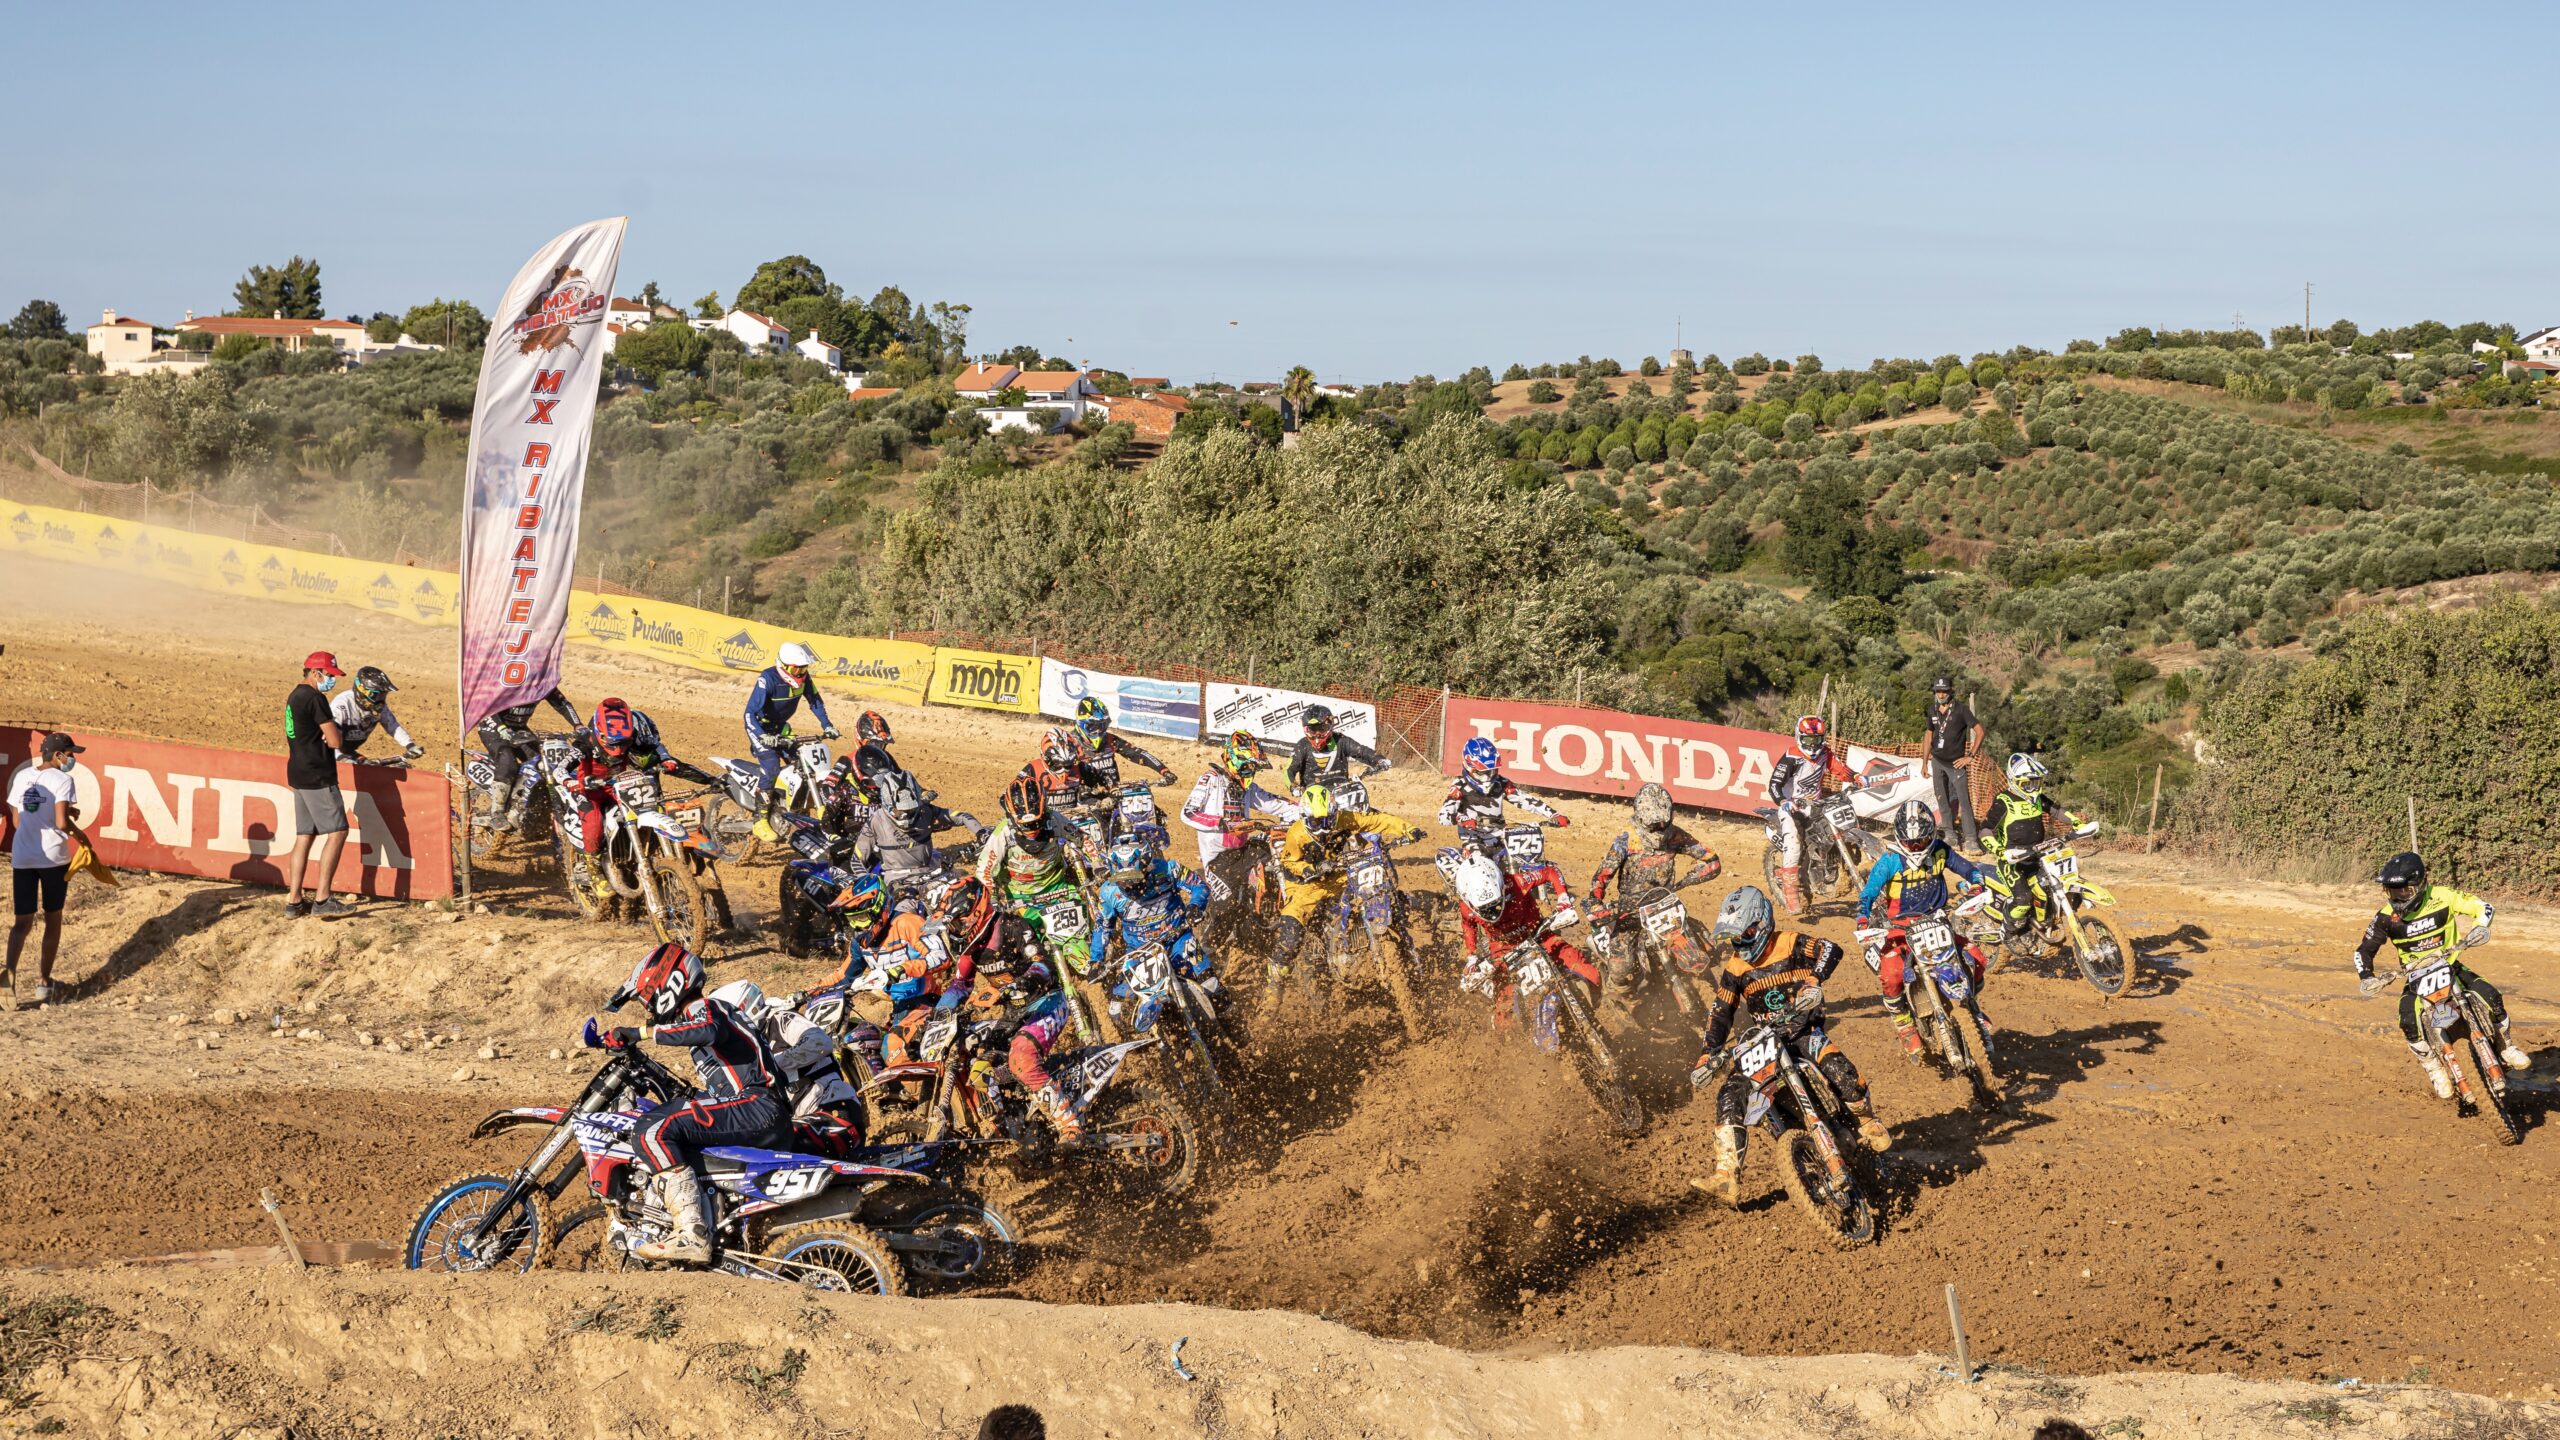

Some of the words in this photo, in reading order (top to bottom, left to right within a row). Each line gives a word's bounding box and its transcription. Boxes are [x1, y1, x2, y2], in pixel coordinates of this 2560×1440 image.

[542, 289, 573, 312] MX
[513, 294, 604, 335] RIBATEJO
[525, 369, 566, 425] MX
[501, 441, 552, 687] RIBATEJO
[290, 567, 338, 594] Putoline
[583, 611, 628, 633] Putoline
[632, 616, 684, 648] Putoline
[713, 636, 766, 665] Putoline
[1213, 694, 1263, 721] EDAL
[1215, 703, 1264, 729] CARPINTARIA
[1261, 701, 1316, 726] EDAL
[812, 747, 827, 766] 54
[1470, 718, 1779, 802] HONDA
[627, 785, 655, 806] 32
[741, 773, 759, 793] 54
[0, 753, 415, 869] ONDA
[854, 804, 880, 817] KEN
[1046, 794, 1076, 806] AMAHA
[1832, 809, 1854, 825] 95
[1507, 833, 1543, 855] 525
[1772, 835, 1784, 849] 95
[2054, 858, 2073, 876] 77
[1053, 908, 1079, 932] 259
[2406, 917, 2435, 934] KTM
[1912, 925, 1952, 956] 280
[976, 960, 1006, 973] THOR
[2417, 966, 2450, 997] 476
[1740, 1036, 1778, 1077] 994
[765, 1168, 827, 1197] 951
